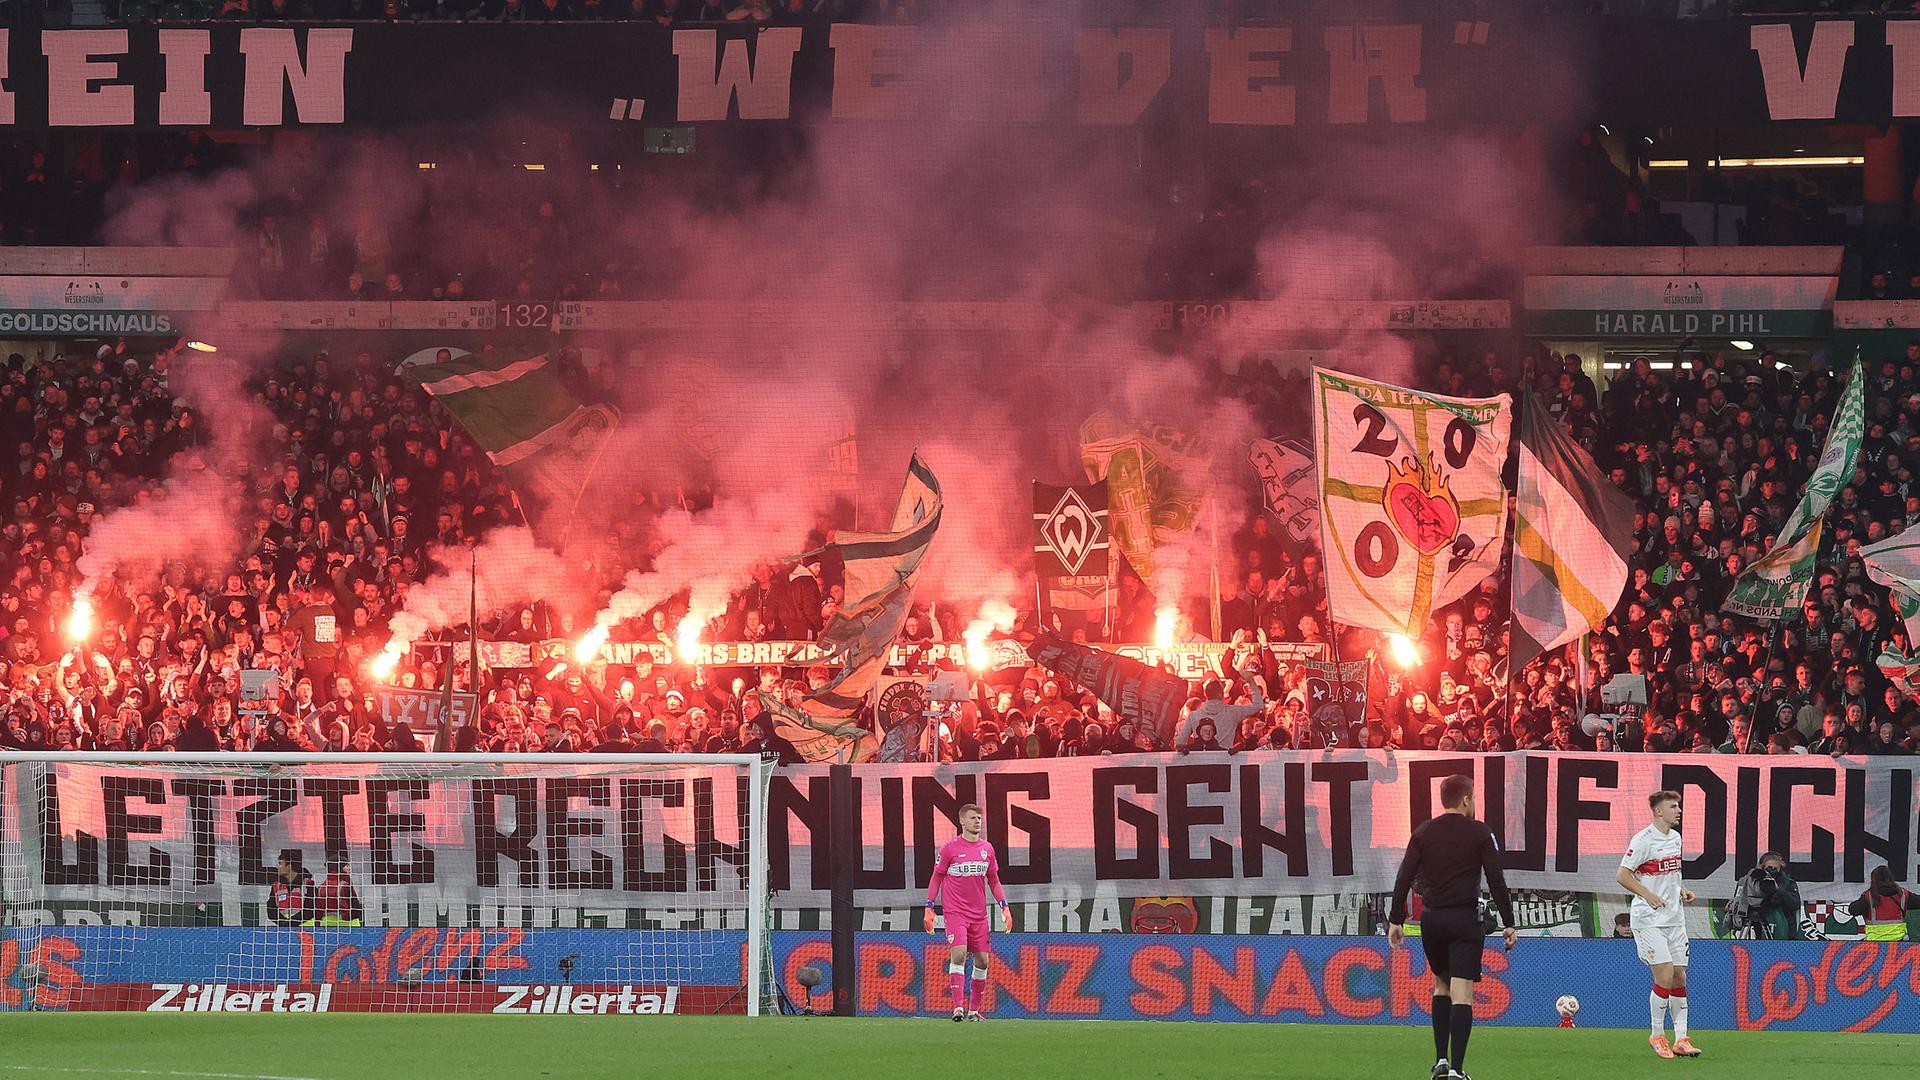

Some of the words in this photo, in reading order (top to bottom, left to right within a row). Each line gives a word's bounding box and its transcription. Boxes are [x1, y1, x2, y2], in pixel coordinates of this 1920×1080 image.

[0, 27, 353, 126] EIN
[0, 313, 171, 333] GOLDSCHMAUS
[501, 304, 548, 327] 132
[1595, 314, 1699, 333] HARALD
[1712, 314, 1770, 333] PIHL
[43, 772, 435, 886] LETZTE
[473, 773, 1050, 892] RECHNUNG
[1093, 762, 1369, 881] GEHT
[1661, 765, 1920, 884] DICH
[147, 984, 332, 1012] Zillertal
[493, 985, 679, 1014] Zillertal
[1732, 942, 1920, 1033] Loren
